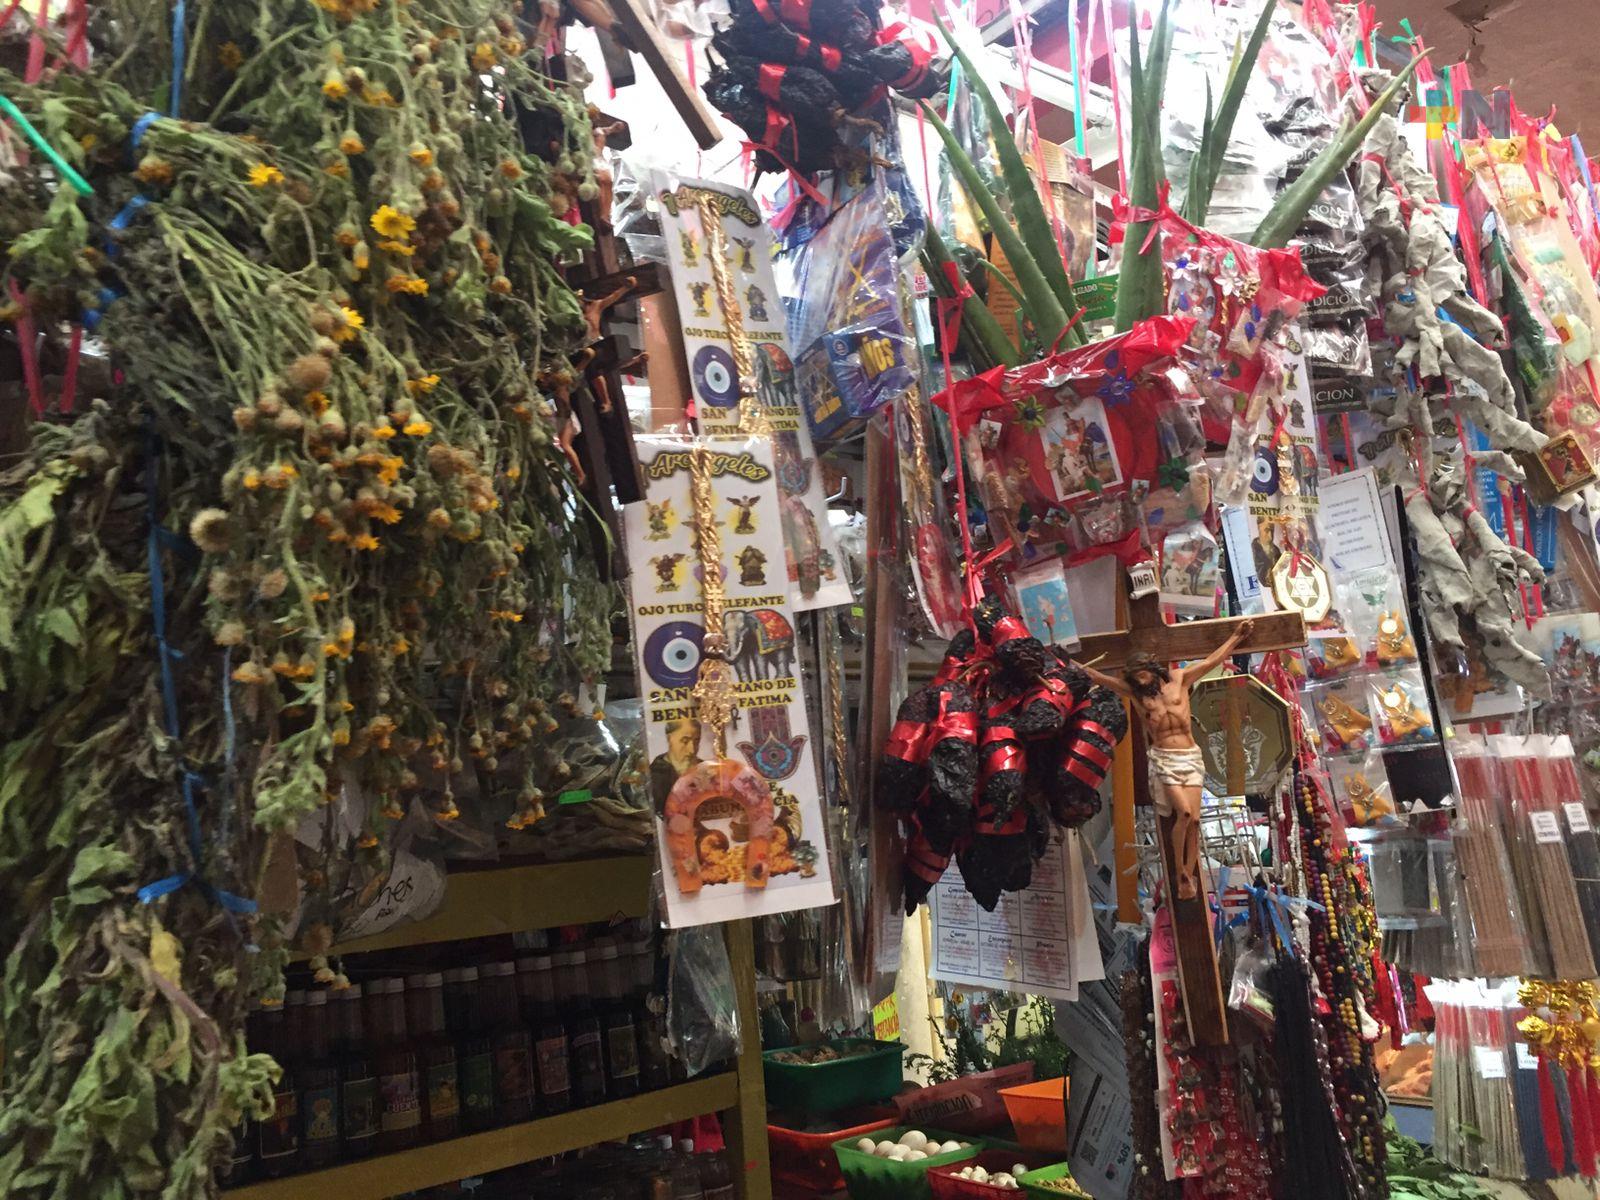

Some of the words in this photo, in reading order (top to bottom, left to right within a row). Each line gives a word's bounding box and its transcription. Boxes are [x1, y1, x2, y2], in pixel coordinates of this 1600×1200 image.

[675, 185, 758, 225] Arcgeles
[685, 327, 703, 337] OJO
[704, 329, 728, 339] TURC
[701, 407, 727, 419] SAN
[767, 408, 785, 417] ANO
[788, 408, 800, 416] DE
[770, 421, 799, 430] ATIMA
[650, 453, 769, 480] Arcgeles
[1248, 493, 1267, 502] SAN
[1249, 506, 1280, 516] BENIT
[1133, 572, 1155, 588] INRI
[638, 605, 664, 616] OJO
[667, 602, 704, 614] TURC
[777, 678, 796, 690] DE
[650, 689, 688, 703] SAN
[739, 694, 793, 706] FATIMA
